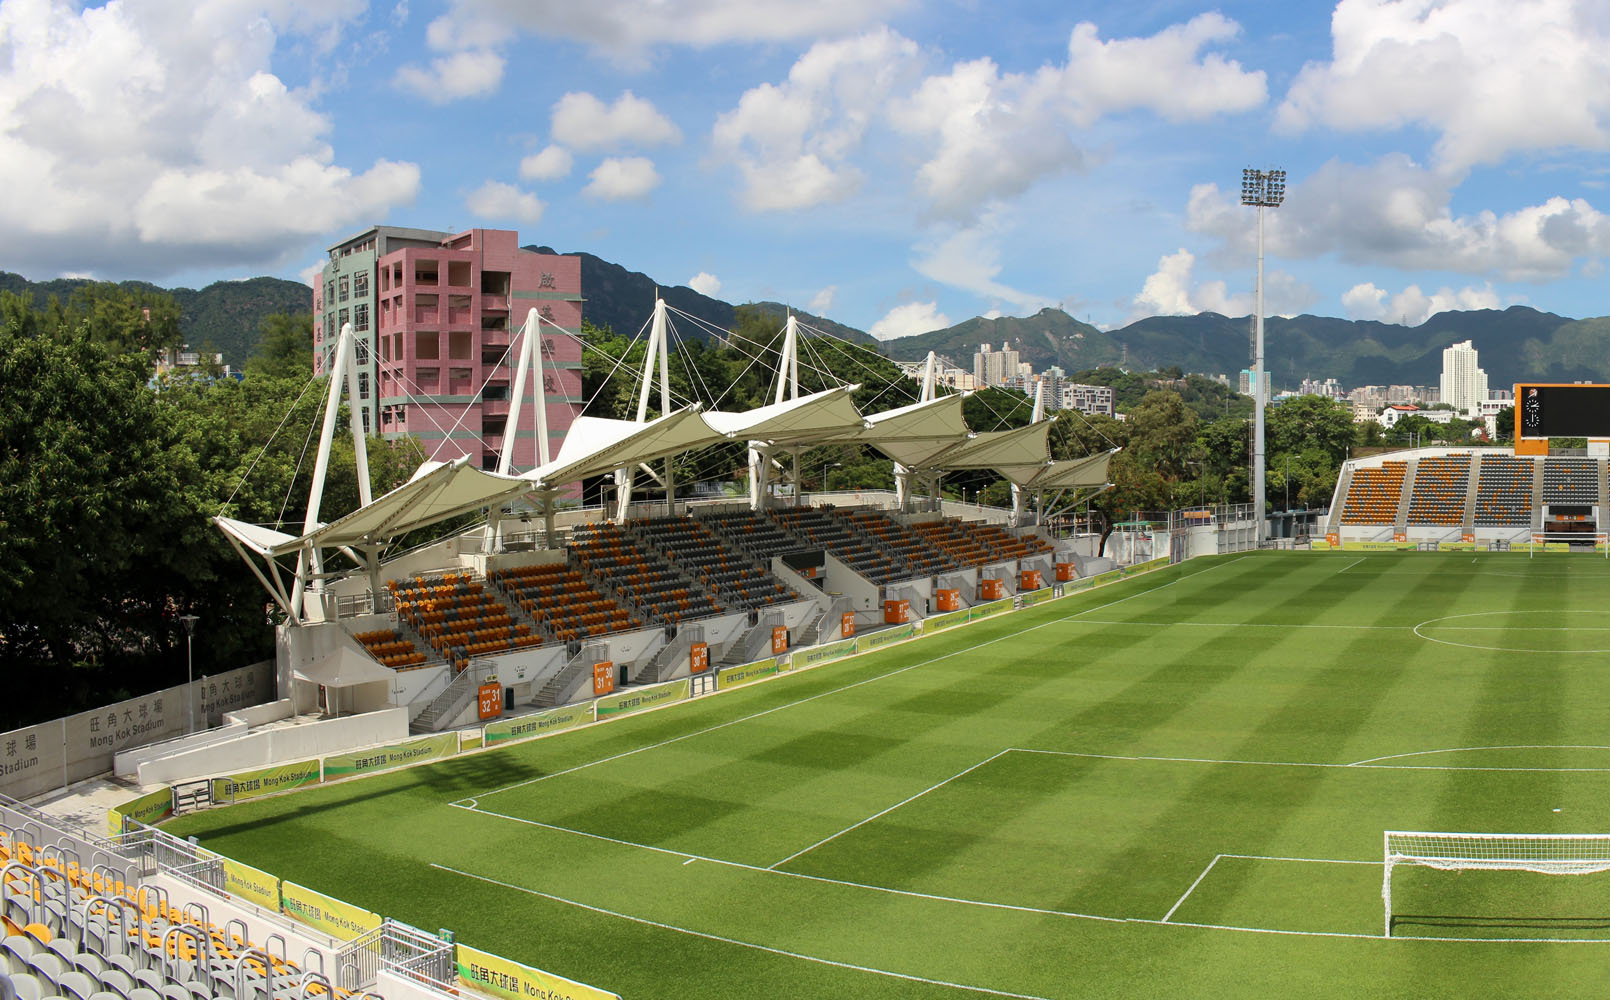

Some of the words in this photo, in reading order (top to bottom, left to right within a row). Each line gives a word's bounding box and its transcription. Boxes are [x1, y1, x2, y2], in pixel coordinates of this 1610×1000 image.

[605, 666, 613, 678] 30
[597, 677, 604, 689] 31
[491, 689, 500, 702] 31
[482, 699, 491, 712] 32
[90, 699, 163, 732] 旺角大球場
[90, 734, 114, 748] Mong
[115, 728, 131, 740] Kok
[132, 718, 164, 735] Stadium
[6, 734, 36, 756] 球場
[471, 963, 519, 993] 旺角大球場
